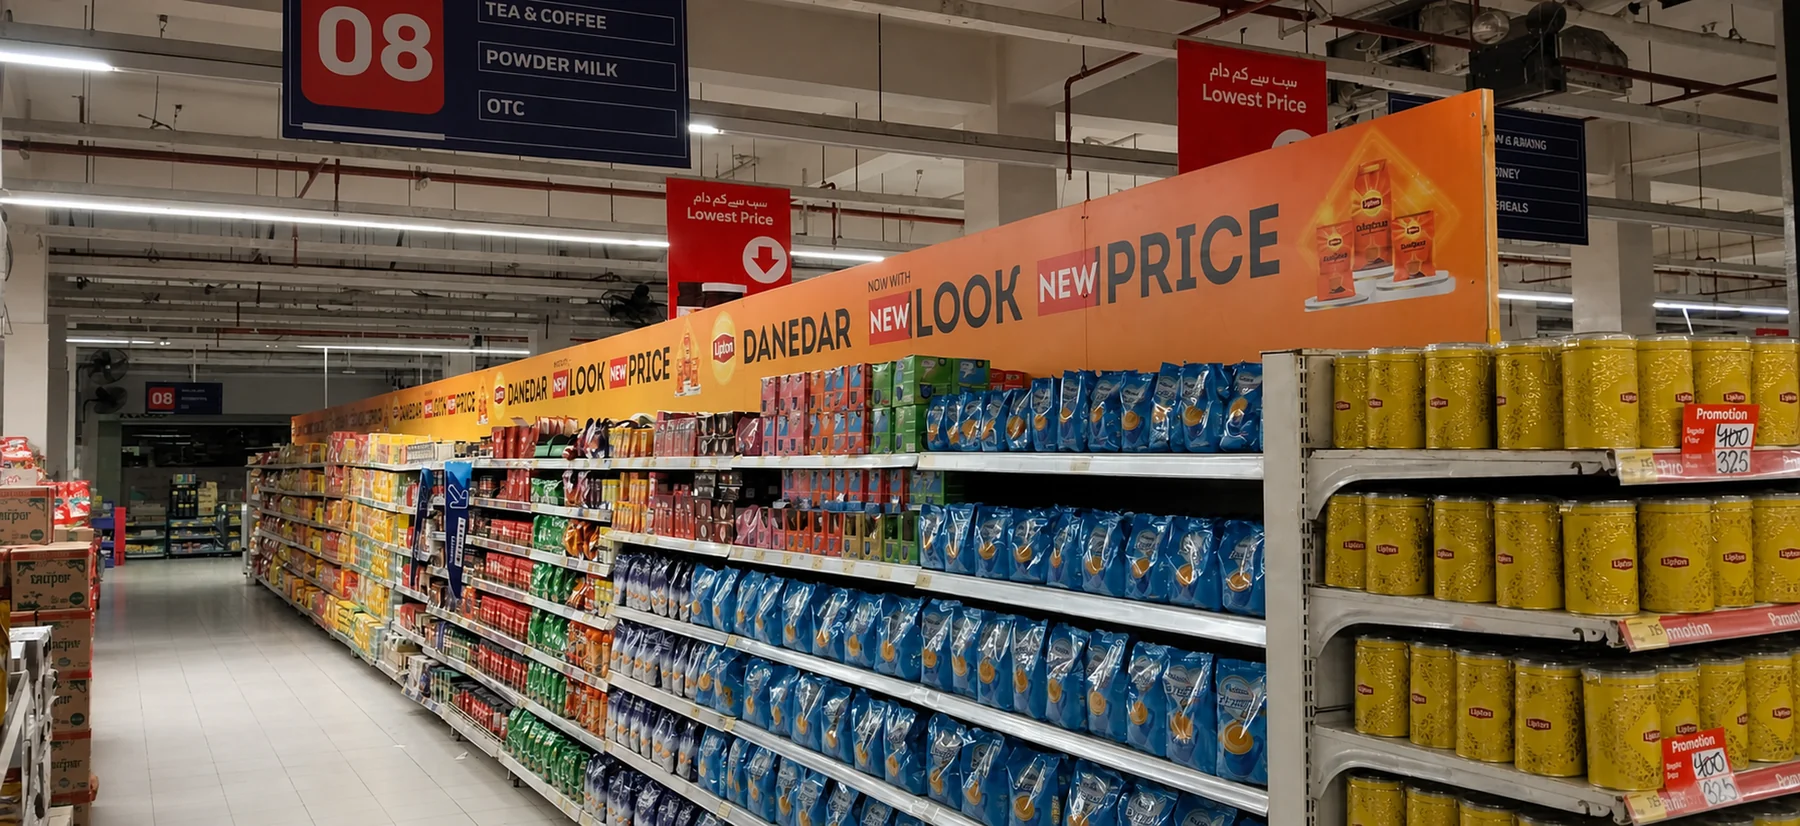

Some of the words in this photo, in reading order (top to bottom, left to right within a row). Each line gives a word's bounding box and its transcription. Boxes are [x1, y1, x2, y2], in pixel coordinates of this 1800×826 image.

[485, 1, 520, 20] TEA
[524, 7, 537, 22] &
[540, 9, 607, 30] COFFEE
[318, 5, 434, 82] 08
[486, 49, 570, 73] POWDER
[574, 61, 618, 78] MILK
[487, 99, 525, 117] OTC
[1202, 83, 1262, 108] Lowest
[1267, 92, 1307, 114] Price
[687, 207, 737, 223] Lowest
[741, 211, 773, 225] Price
[743, 308, 852, 364] DANEDAR
[869, 302, 910, 334] NEW
[916, 265, 1023, 338] LOOK
[1039, 261, 1098, 303] NEW
[1107, 203, 1280, 304] PRICE
[868, 276, 888, 293] NOW
[889, 270, 911, 289] WITH
[714, 339, 734, 356] Lipton
[507, 376, 548, 406] DANEDAR
[569, 361, 607, 396] LOOK
[610, 363, 627, 382] NEW
[628, 346, 670, 386] PRICE
[152, 392, 173, 405] 08
[1696, 408, 1748, 421] Promotion
[1717, 450, 1749, 474] 325
[1672, 735, 1716, 753] Promotion
[1703, 778, 1737, 805] 325
